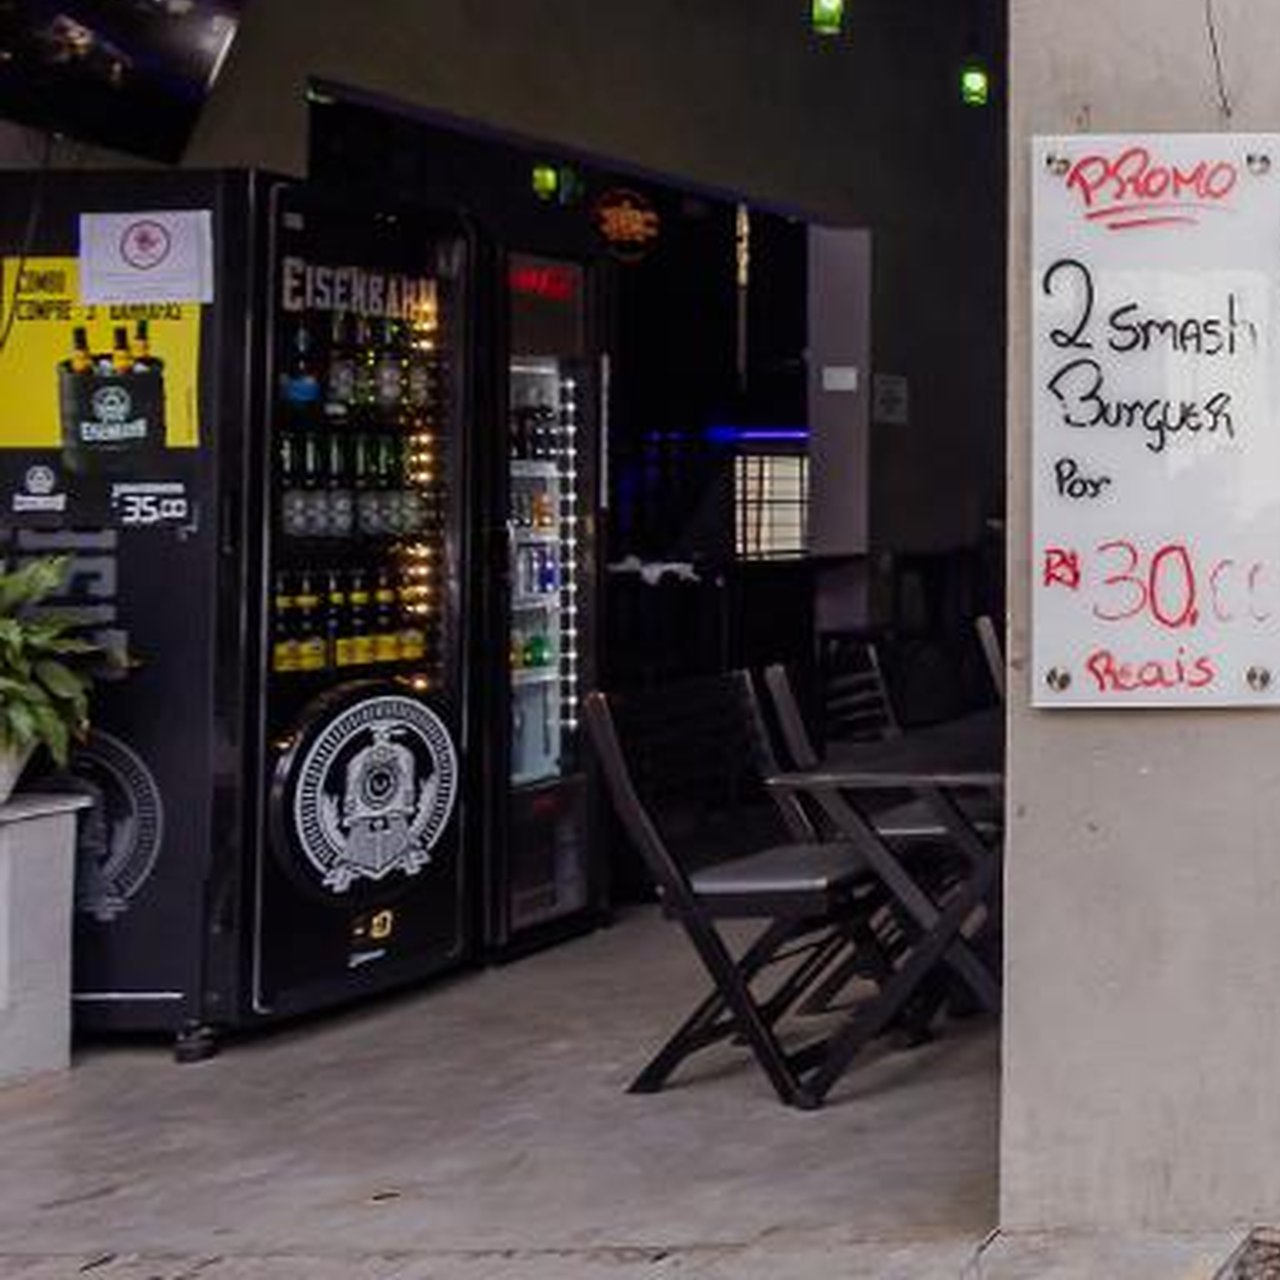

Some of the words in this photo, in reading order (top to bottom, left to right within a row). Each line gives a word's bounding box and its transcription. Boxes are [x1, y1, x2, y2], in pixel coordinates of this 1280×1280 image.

[1066, 148, 1238, 206] PROMO
[1043, 258, 1094, 349] 2
[1054, 458, 1112, 498] Por
[1087, 646, 1216, 691] Reais
